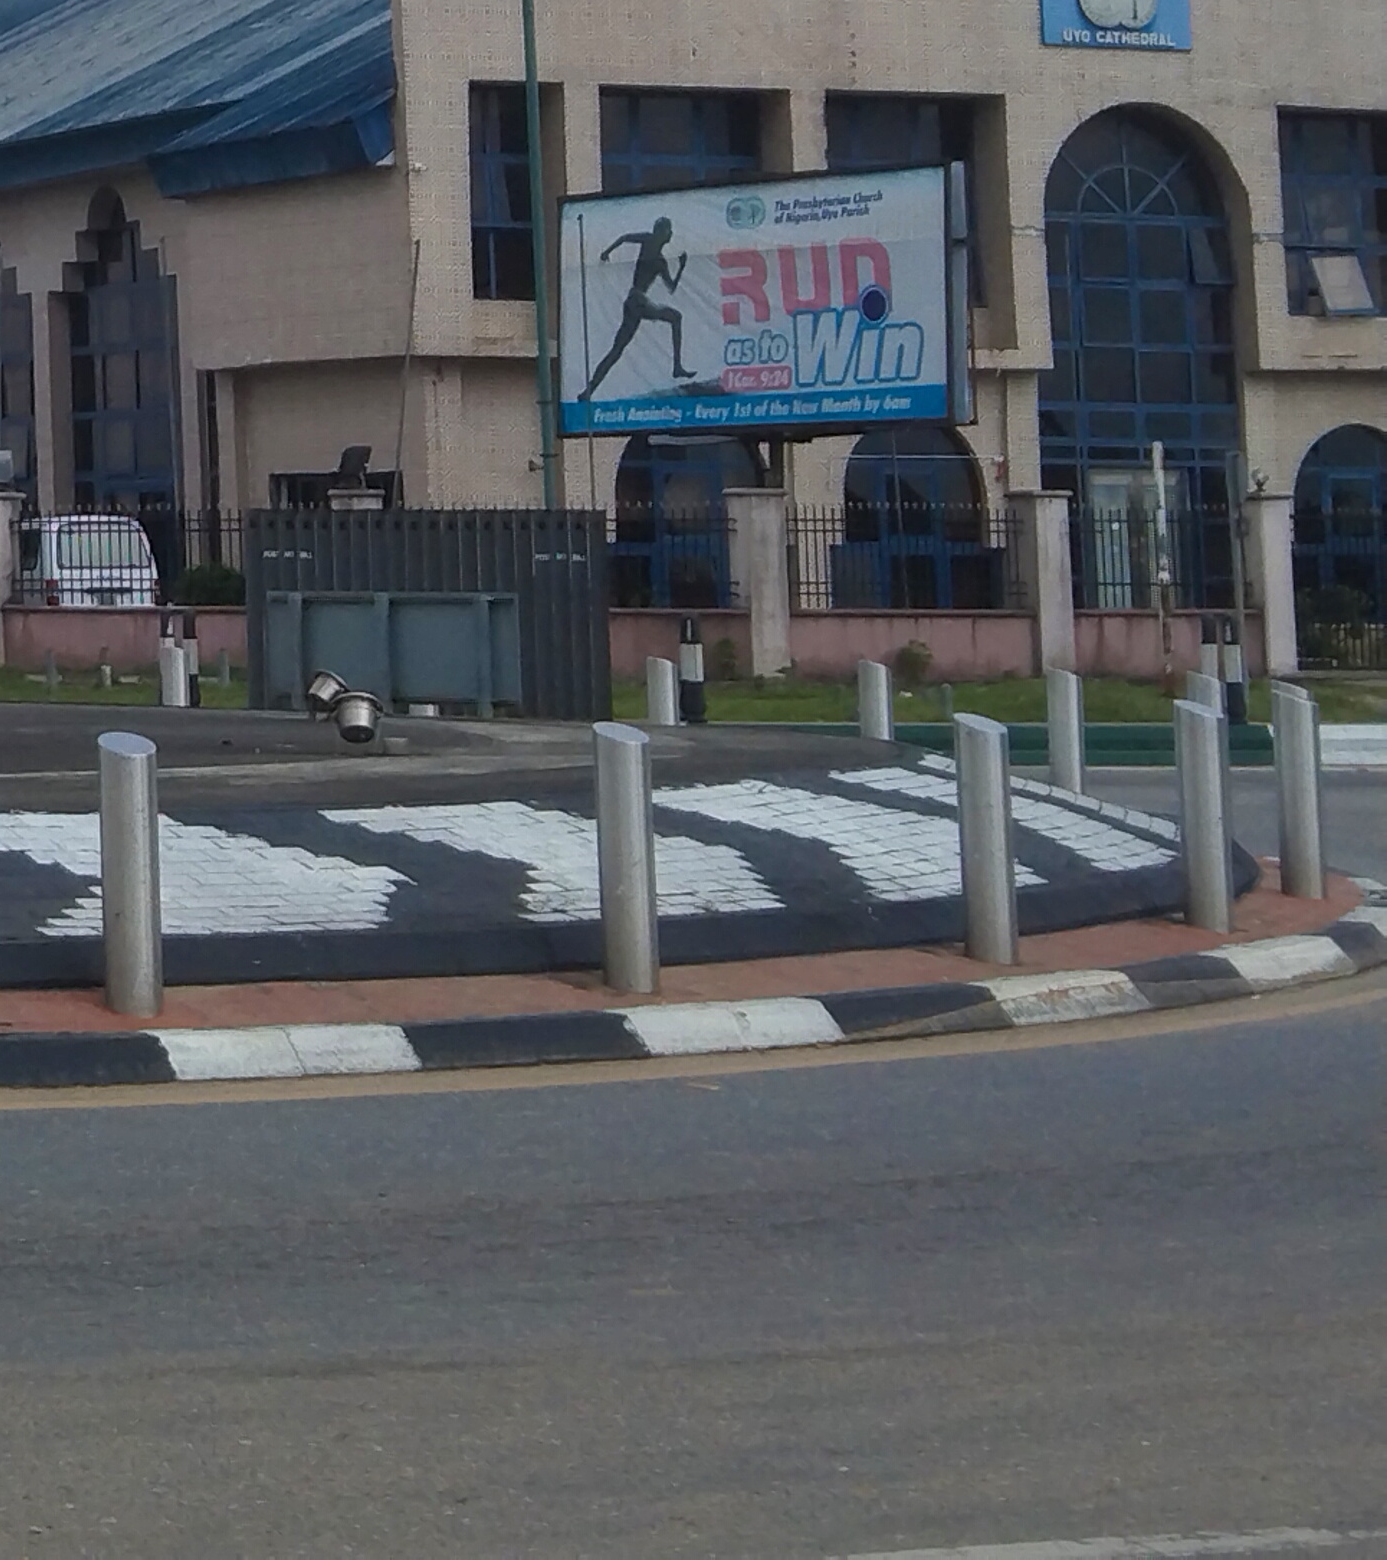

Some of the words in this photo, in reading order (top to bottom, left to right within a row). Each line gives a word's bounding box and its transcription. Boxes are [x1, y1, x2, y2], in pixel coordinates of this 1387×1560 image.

[1063, 29, 1090, 42] UYO
[1096, 31, 1176, 47] CATHEDRAL
[774, 200, 791, 211] The
[853, 190, 883, 204] Church
[774, 211, 785, 224] of
[840, 203, 870, 218] Parish
[718, 237, 893, 325] RUN
[724, 338, 755, 365] as
[758, 329, 788, 363] to
[793, 284, 925, 387] Win
[593, 406, 625, 423] Fresh
[695, 403, 730, 423] Every
[734, 402, 752, 417] 1st
[753, 399, 769, 417] of
[770, 399, 790, 416] the
[821, 396, 861, 413] Month
[863, 394, 880, 414] by
